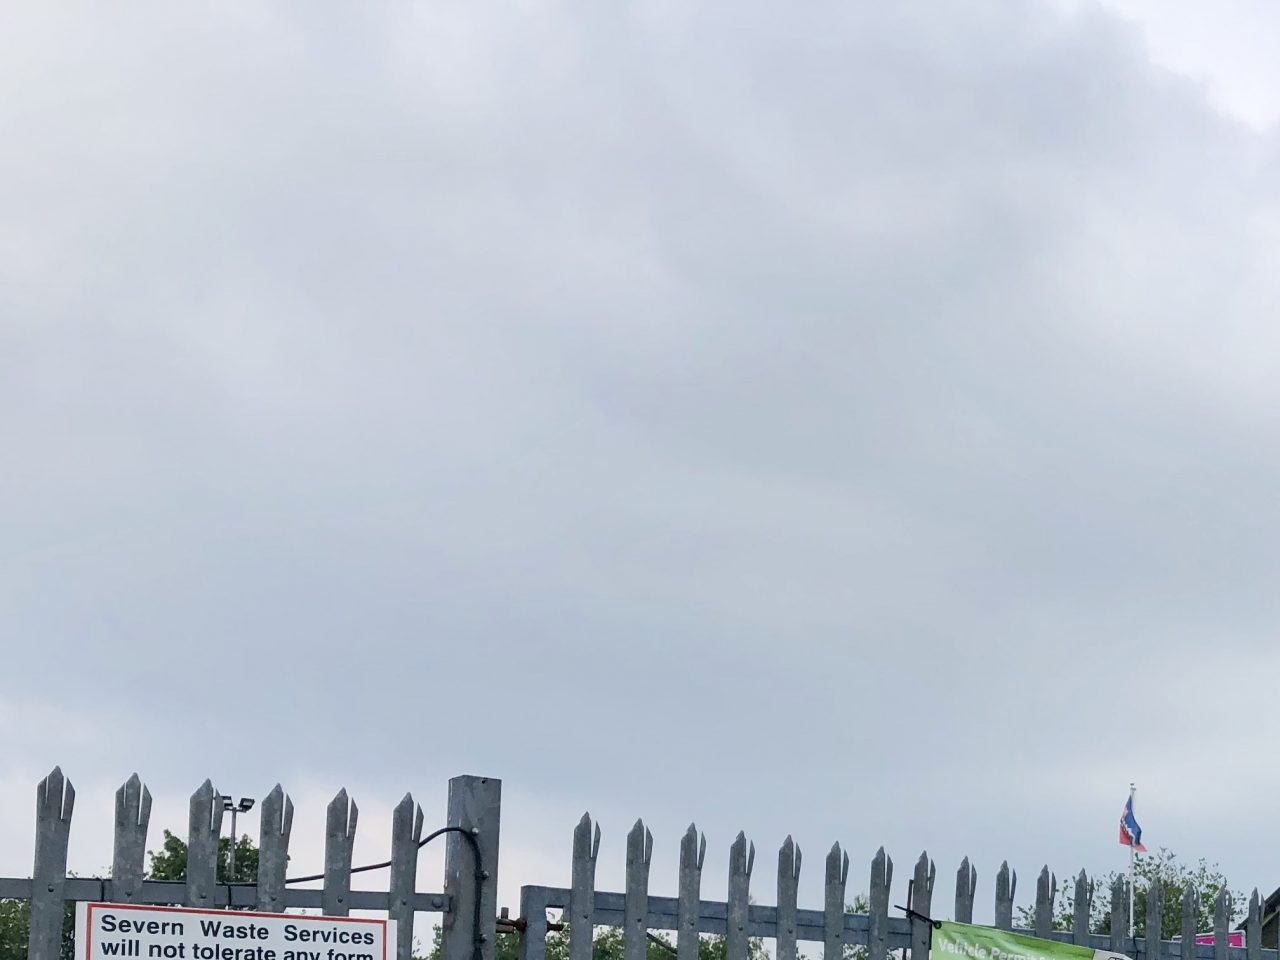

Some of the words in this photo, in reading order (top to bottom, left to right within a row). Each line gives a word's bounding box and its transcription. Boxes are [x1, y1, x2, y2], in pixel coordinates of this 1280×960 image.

[101, 914, 184, 935] Severn
[201, 920, 269, 940] Waste
[284, 924, 375, 945] Services
[101, 939, 139, 957] will
[149, 942, 185, 959] not
